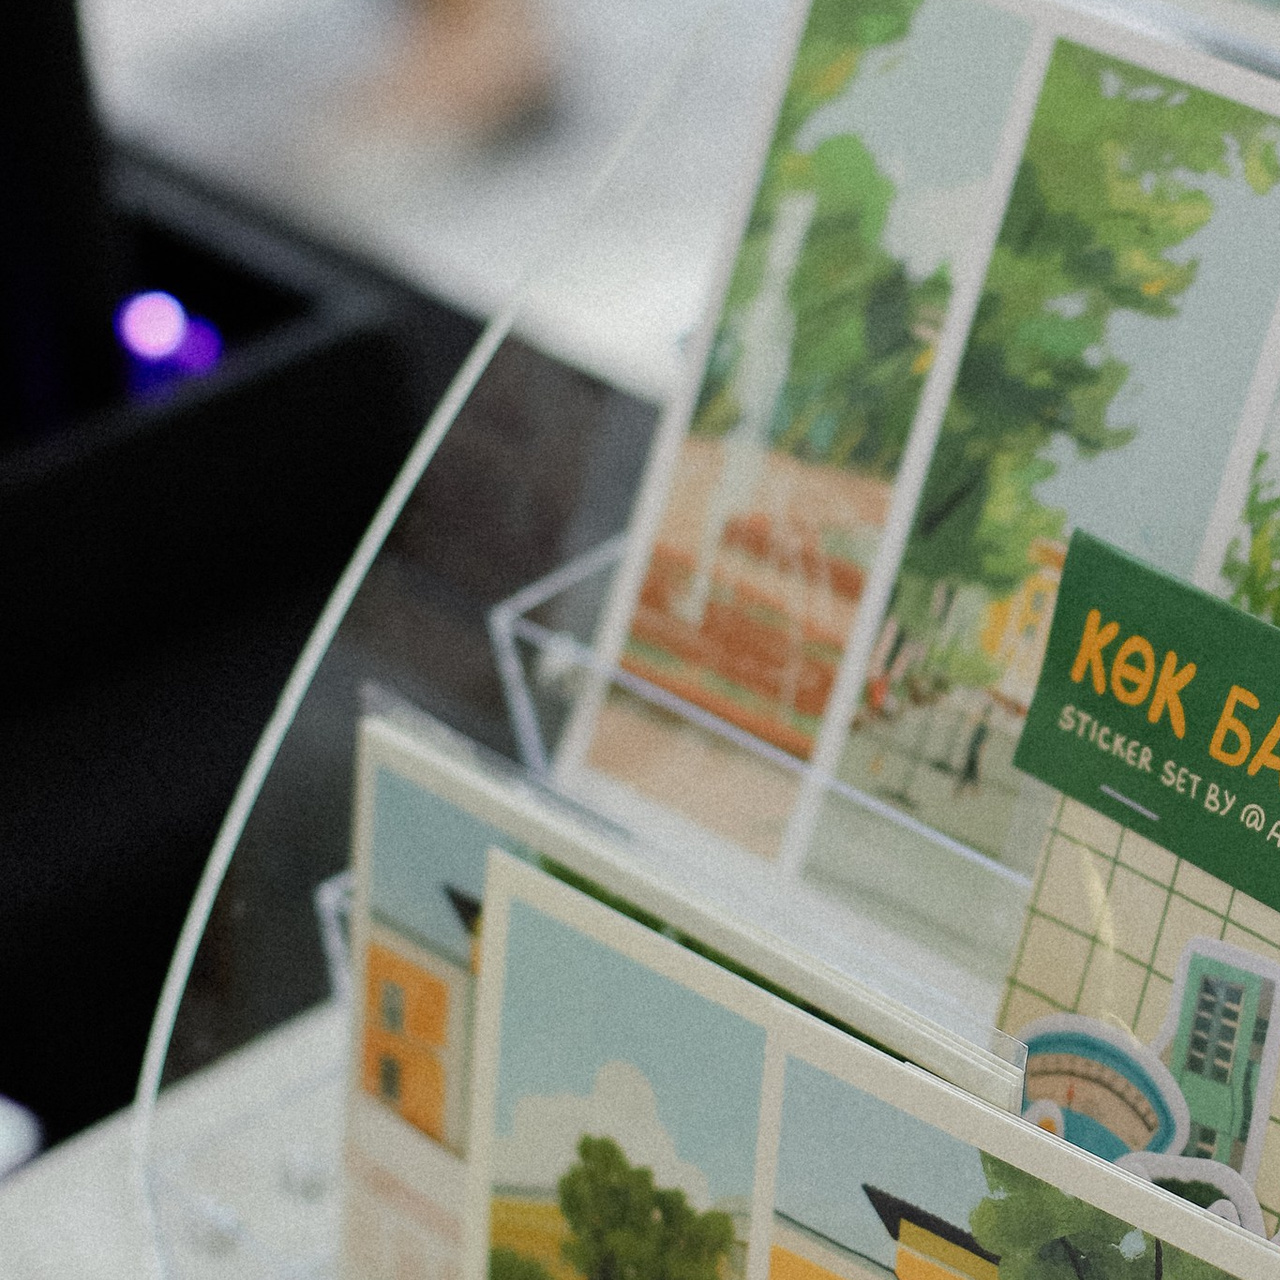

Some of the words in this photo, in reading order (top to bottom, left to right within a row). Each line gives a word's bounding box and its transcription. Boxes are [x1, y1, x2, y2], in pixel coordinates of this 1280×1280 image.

[1071, 608, 1197, 740] КӨК
[1058, 704, 1155, 772] STICKER
[1160, 760, 1202, 799] SET
[1203, 782, 1237, 816] BY
